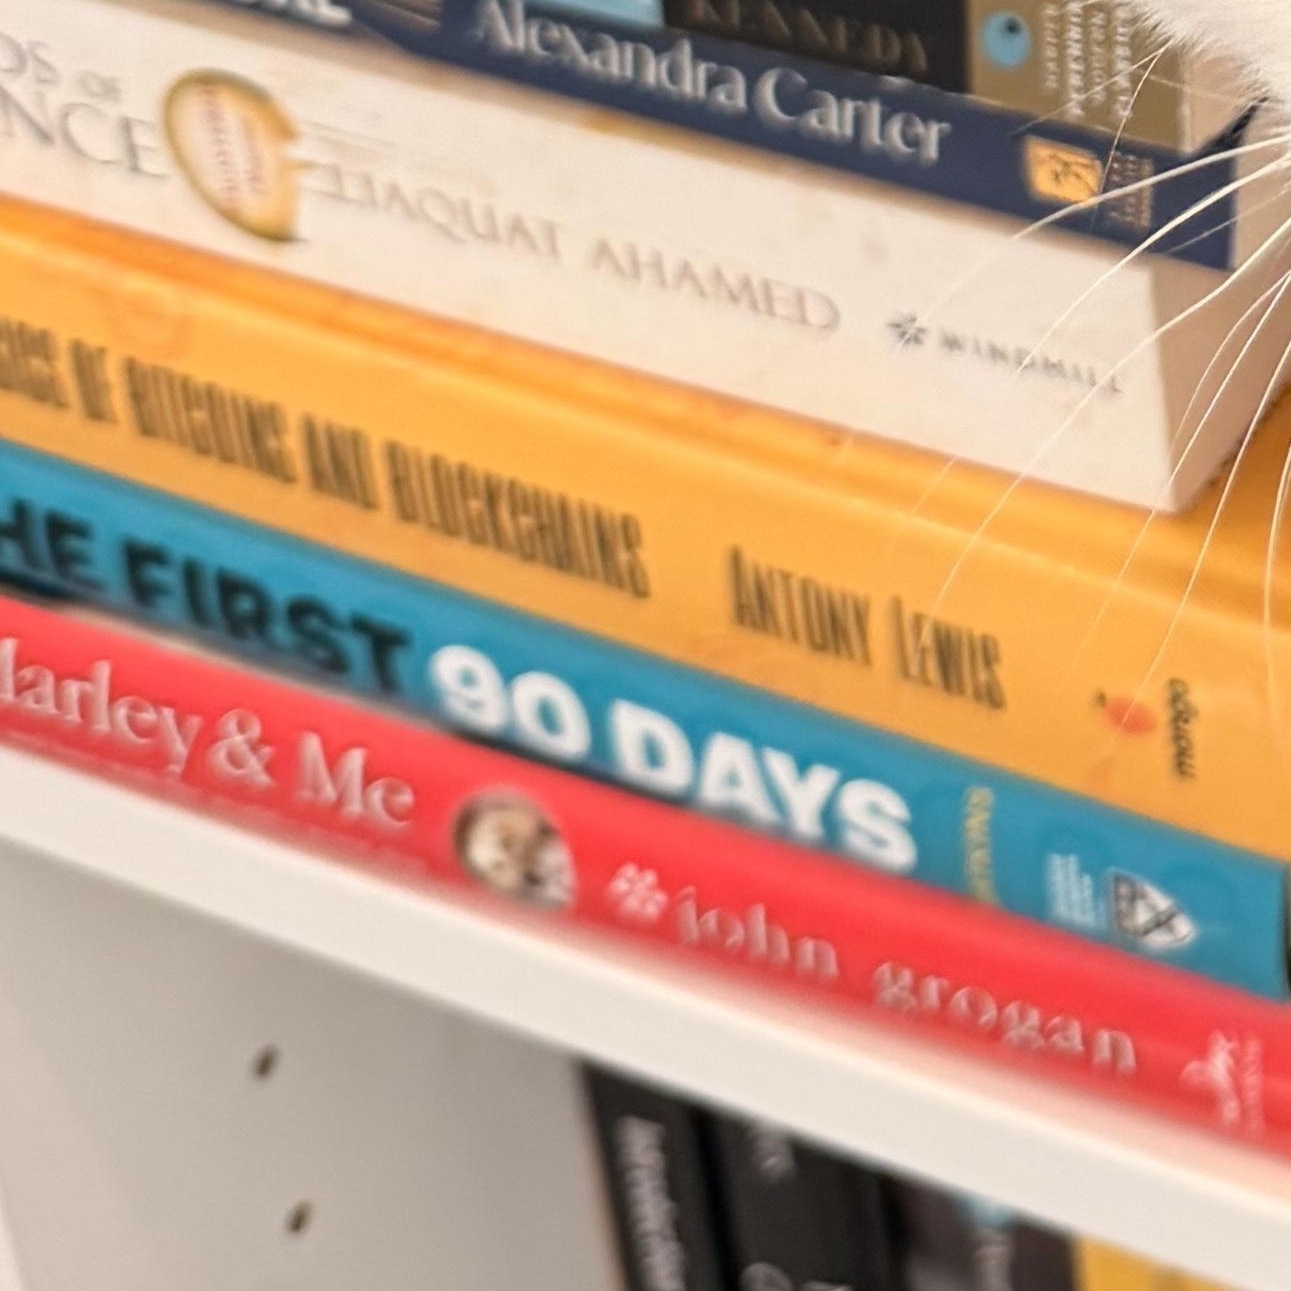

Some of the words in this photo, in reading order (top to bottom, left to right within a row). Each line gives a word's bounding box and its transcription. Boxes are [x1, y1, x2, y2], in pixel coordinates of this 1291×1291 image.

[753, 66, 950, 166] Carter
[592, 233, 840, 333] AHAMED
[119, 536, 412, 691] FIRST
[428, 644, 591, 761] 90
[608, 697, 918, 874] DAYS
[729, 546, 871, 666] ANTONY
[892, 597, 1006, 711] LEWIS
[206, 707, 275, 788] &
[297, 731, 414, 827] Me
[674, 887, 839, 979] john
[873, 961, 1136, 1077] grogan
